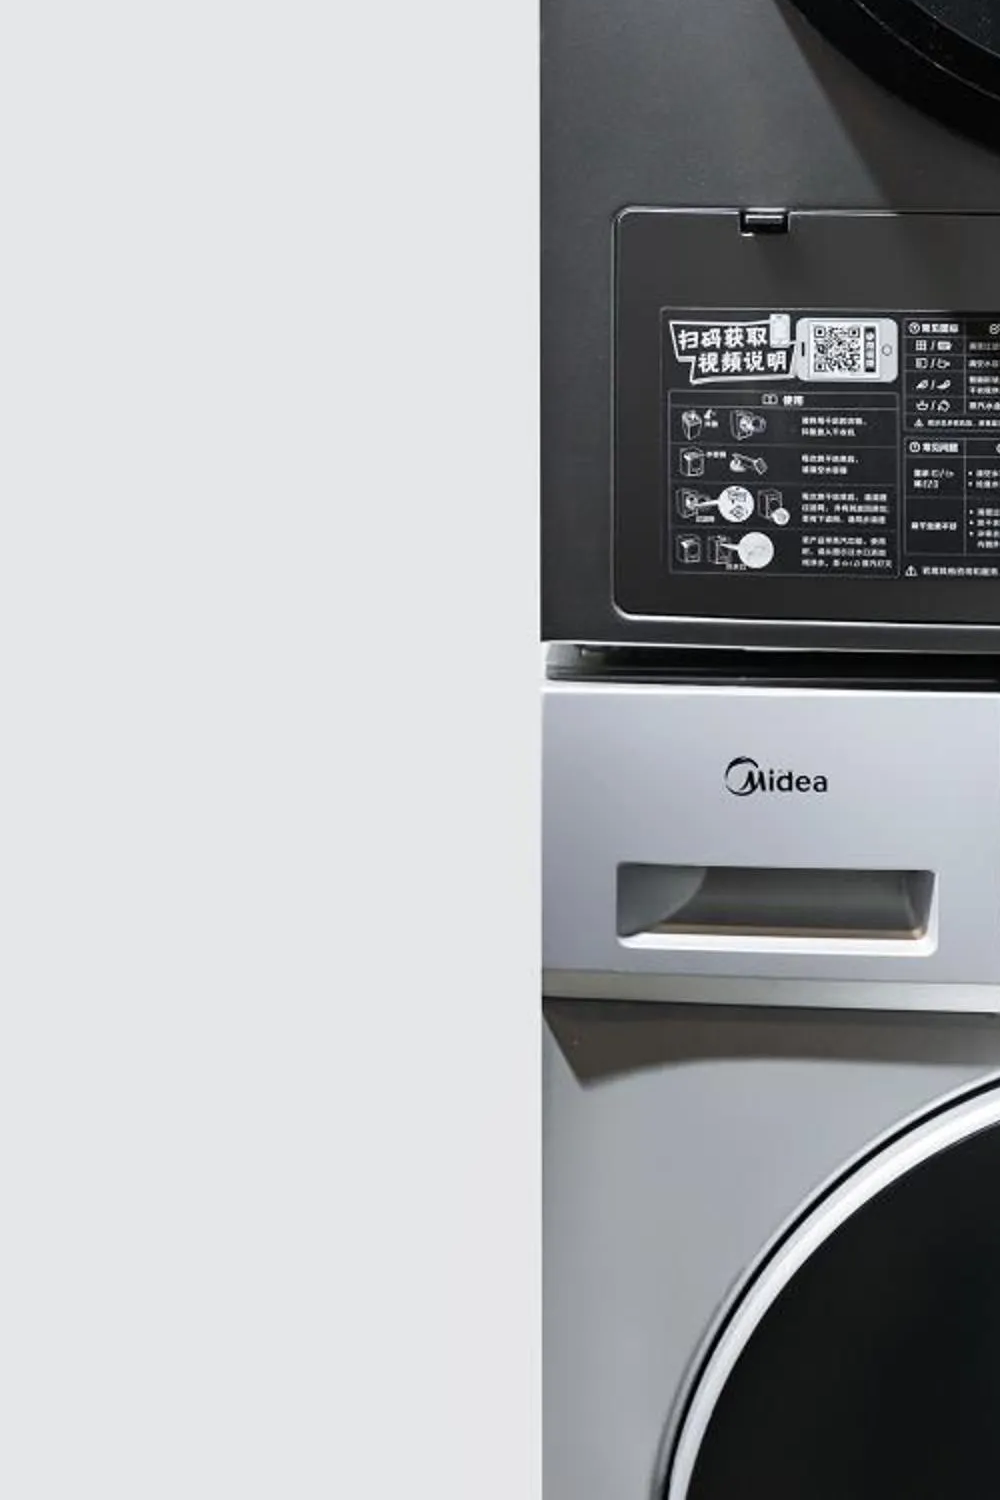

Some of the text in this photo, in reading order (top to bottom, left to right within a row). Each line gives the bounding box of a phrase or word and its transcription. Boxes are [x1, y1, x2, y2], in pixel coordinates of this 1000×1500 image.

[677, 327, 768, 350] 扫码获取
[698, 351, 788, 373] 视频说明
[725, 756, 828, 796] Midea
